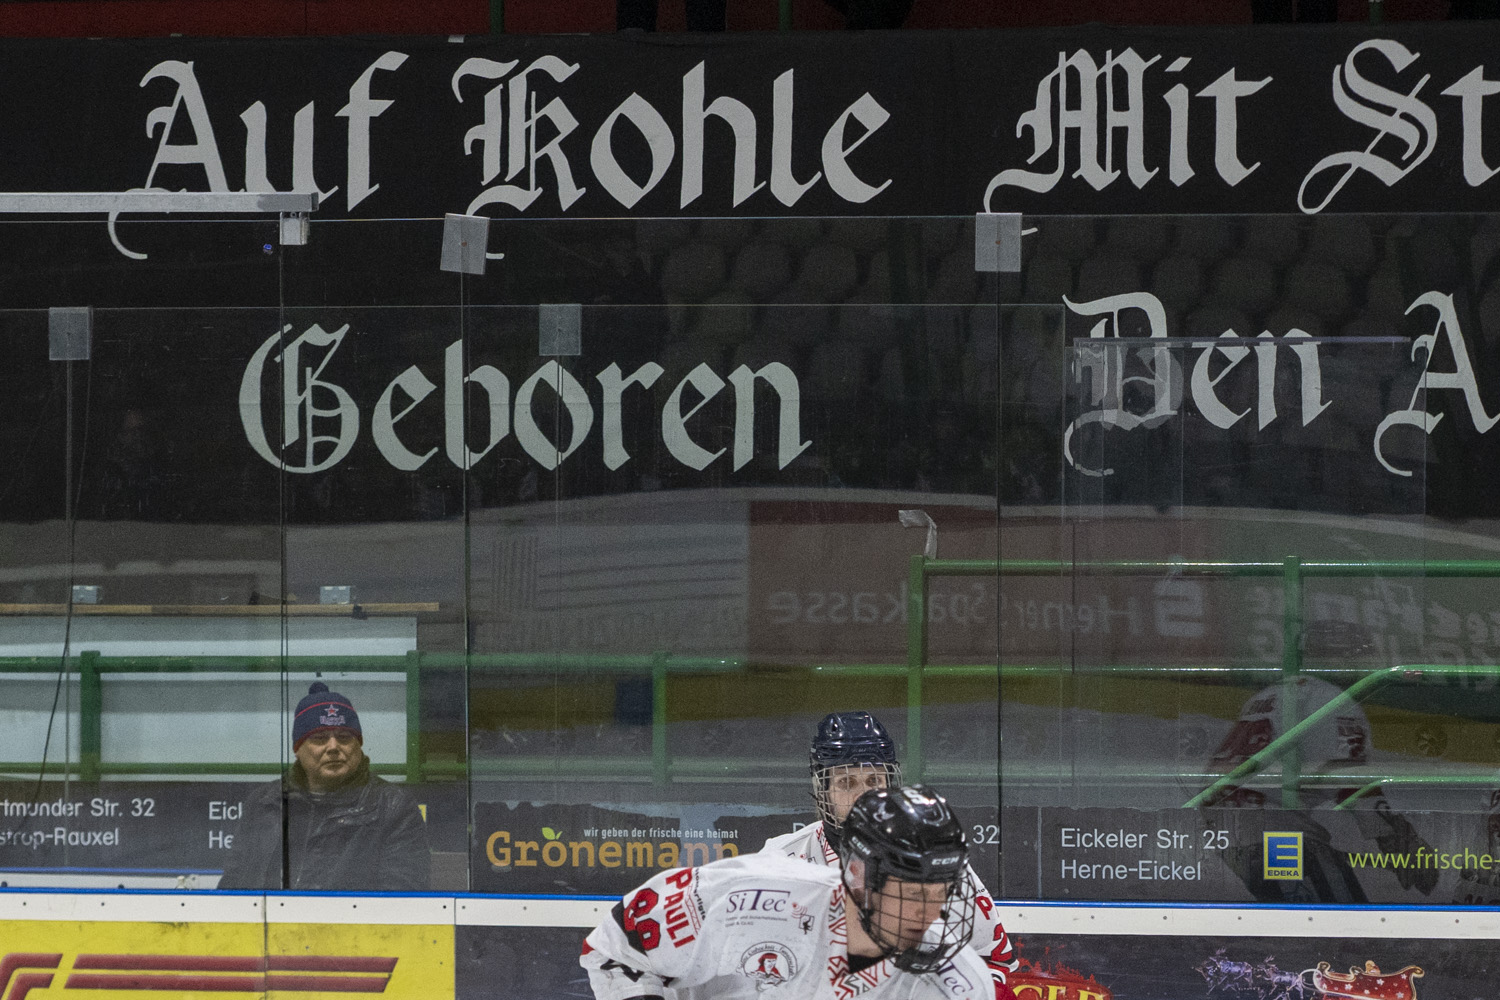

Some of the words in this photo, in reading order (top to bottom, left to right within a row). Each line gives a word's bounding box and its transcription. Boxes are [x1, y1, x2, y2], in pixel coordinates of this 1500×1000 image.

[982, 45, 1272, 236] Mit
[108, 51, 409, 259] Auf
[451, 54, 893, 259] Kohle
[1062, 290, 1332, 476] Den
[238, 322, 813, 475] Geboren
[0, 798, 83, 817] tmunder
[90, 798, 123, 817] Str.
[131, 798, 155, 817] 32
[584, 828, 598, 838] wir
[600, 827, 628, 840] geben
[632, 828, 646, 838] der
[649, 827, 682, 839] frische
[685, 828, 703, 838] eine
[707, 828, 738, 839] heimat
[972, 825, 1000, 845] 32
[1061, 827, 1148, 849] Eickeler
[1156, 829, 1193, 849] Str.
[1203, 830, 1229, 850] 25
[931, 856, 960, 866] CCM
[1061, 859, 1201, 881] Herne-Eickel
[1267, 869, 1299, 877] EDEKA
[664, 867, 697, 949] PAULI
[726, 889, 791, 914] SiTec
